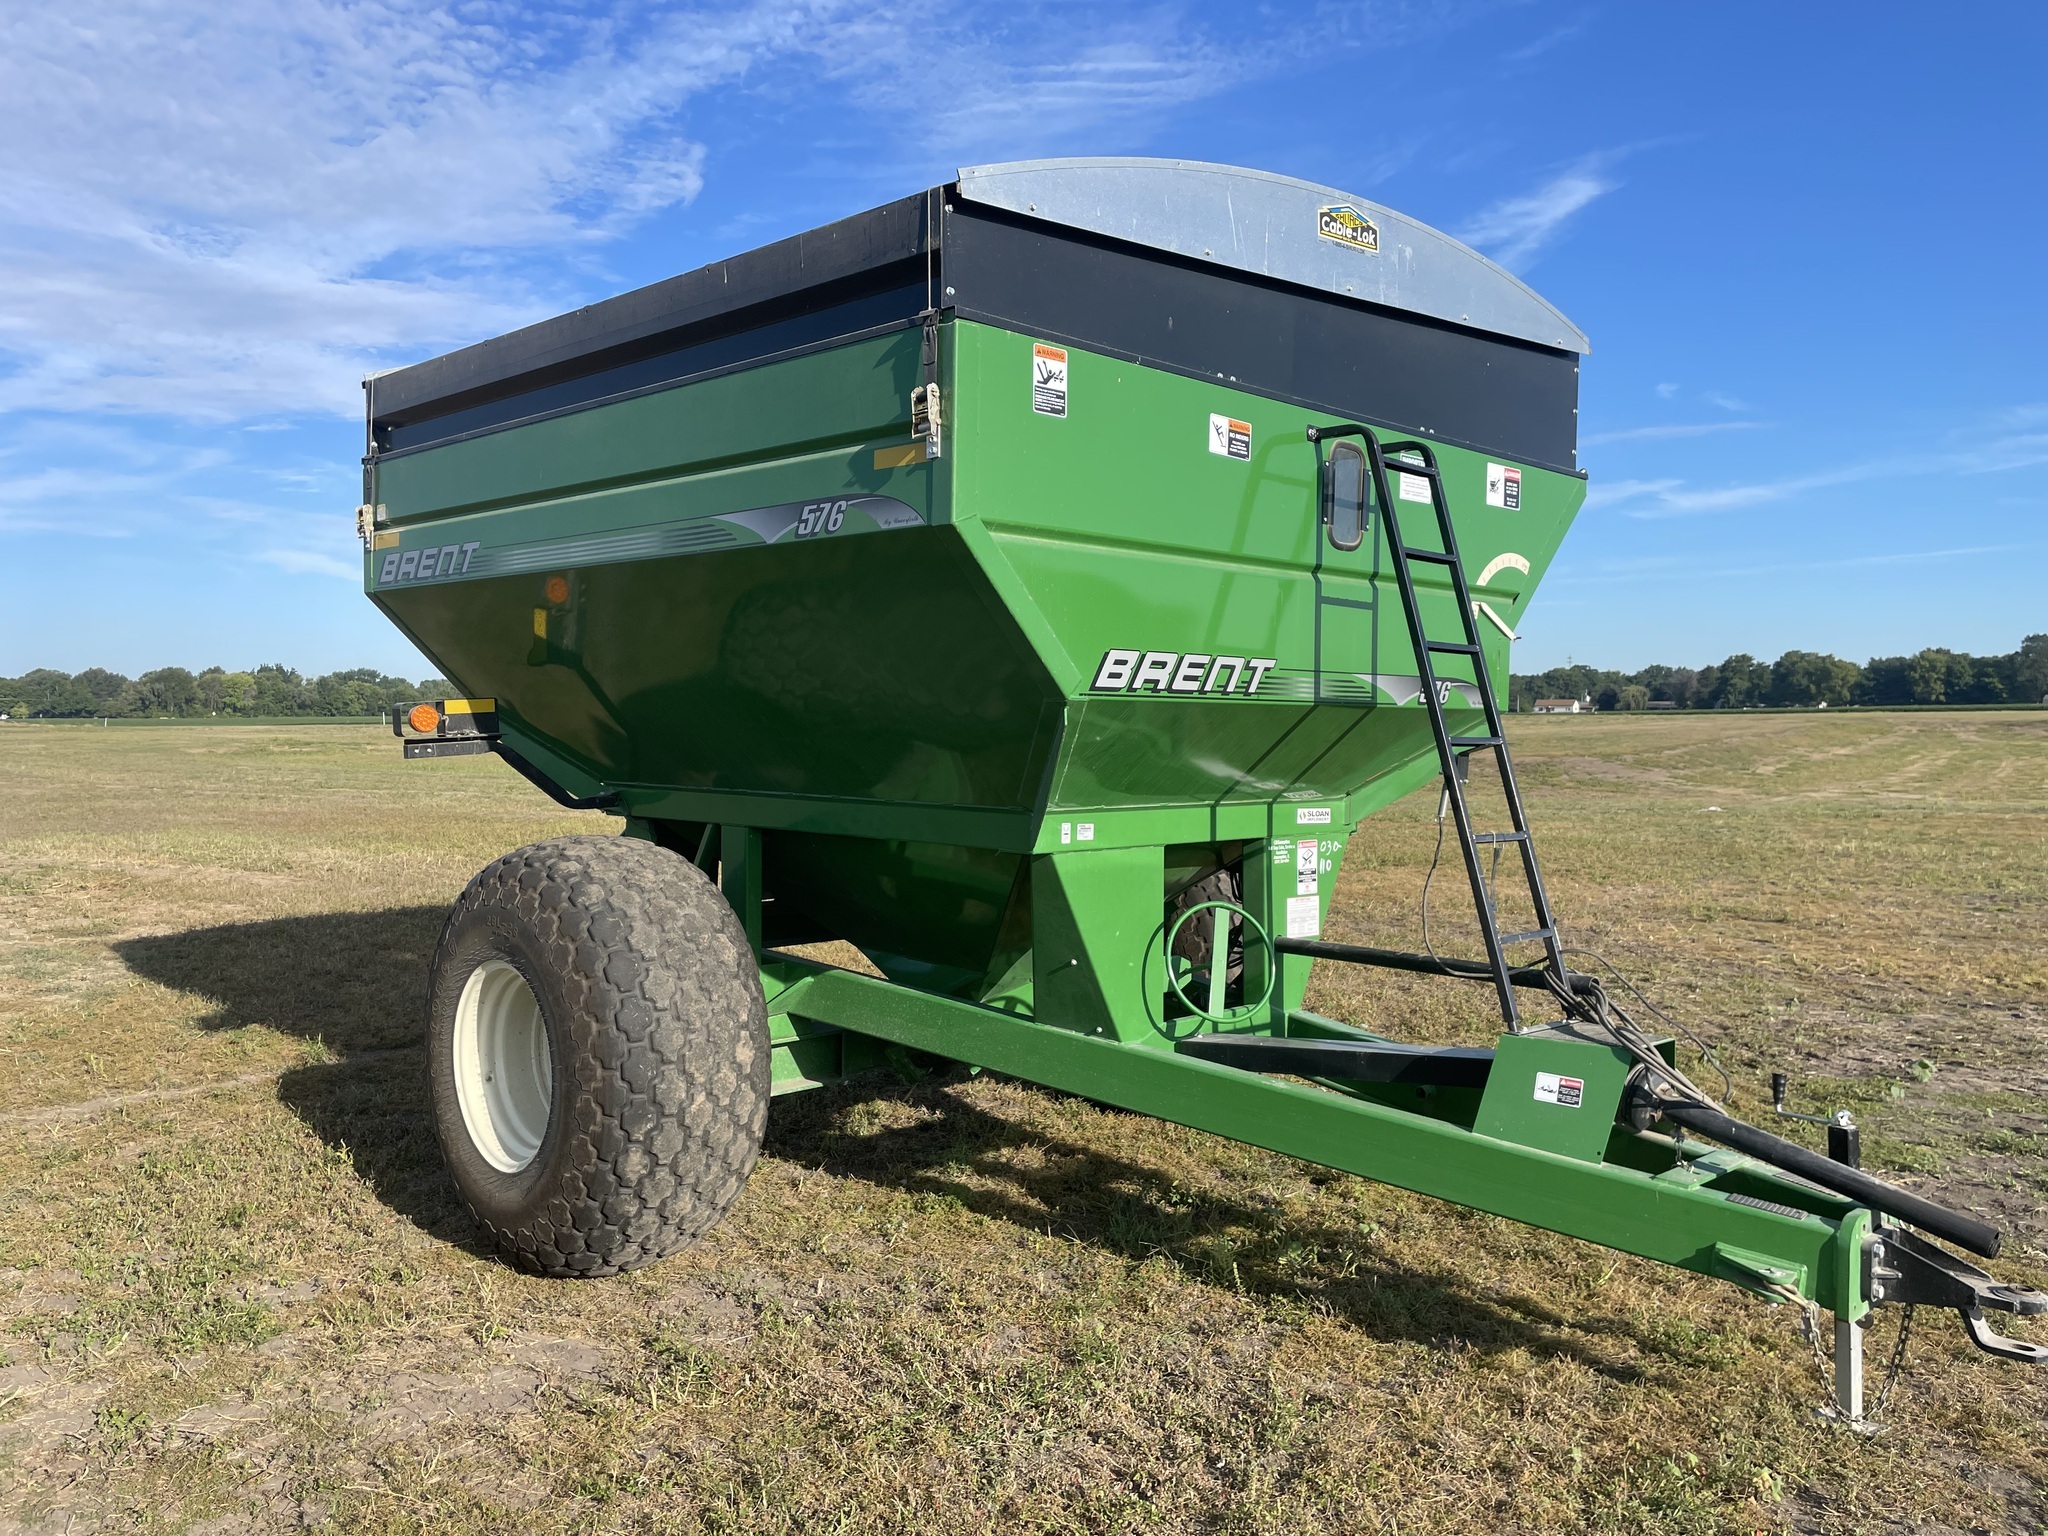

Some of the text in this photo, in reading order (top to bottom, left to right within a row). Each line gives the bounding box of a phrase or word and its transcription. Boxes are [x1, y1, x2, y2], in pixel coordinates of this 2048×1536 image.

[1321, 216, 1376, 246] Cable-Lok
[1041, 349, 1065, 360] WARNING
[795, 500, 848, 538] 576
[378, 540, 481, 585] BRENT
[1090, 648, 1278, 696] BRENT
